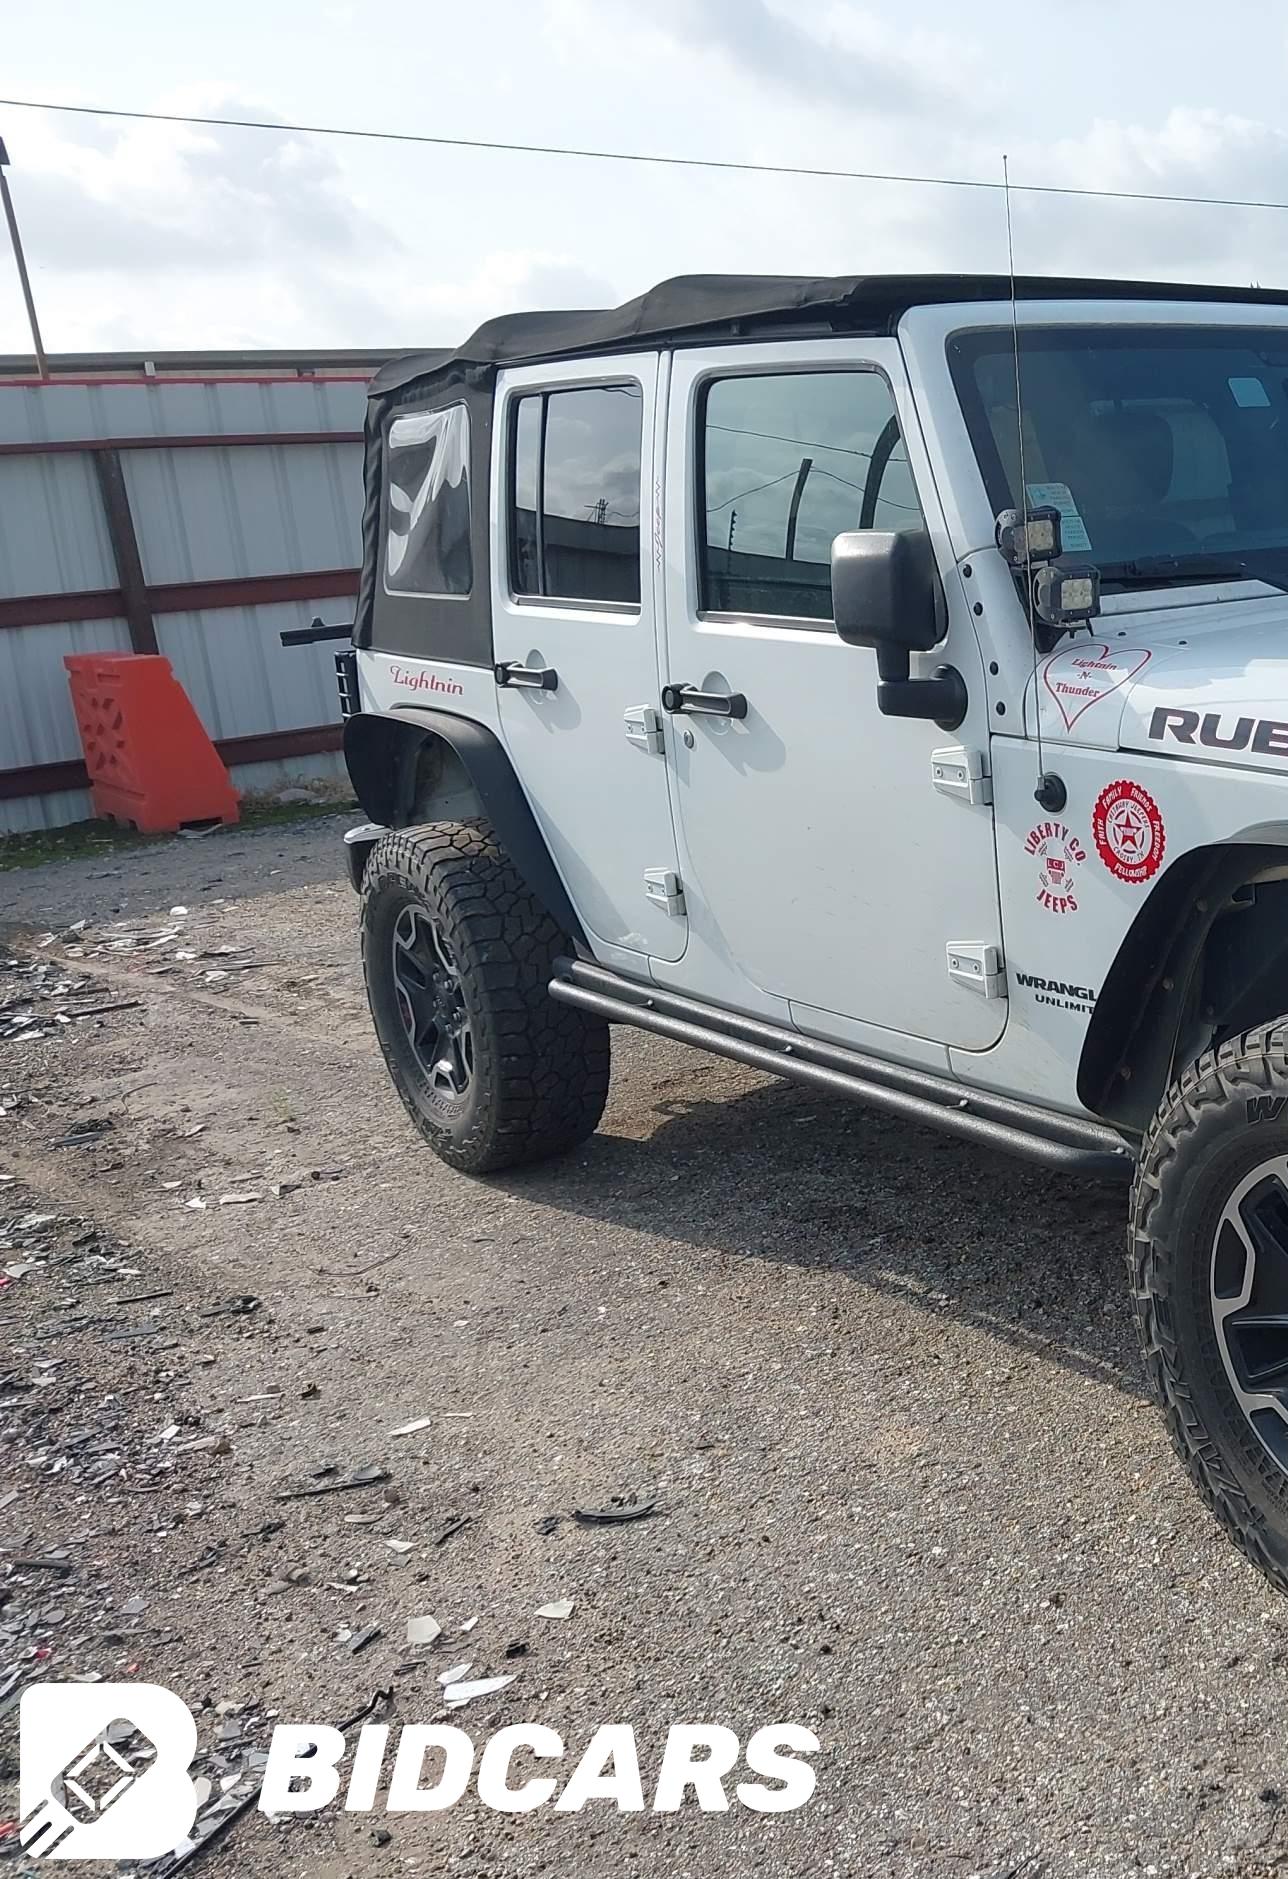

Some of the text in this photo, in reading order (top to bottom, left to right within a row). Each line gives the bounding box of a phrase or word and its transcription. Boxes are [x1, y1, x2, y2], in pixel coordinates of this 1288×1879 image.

[1072, 658, 1118, 671] Lightnin
[1055, 682, 1101, 698] Thunder
[1024, 822, 1086, 867] LIBERTY CO.
[1037, 888, 1078, 914] JEEPS
